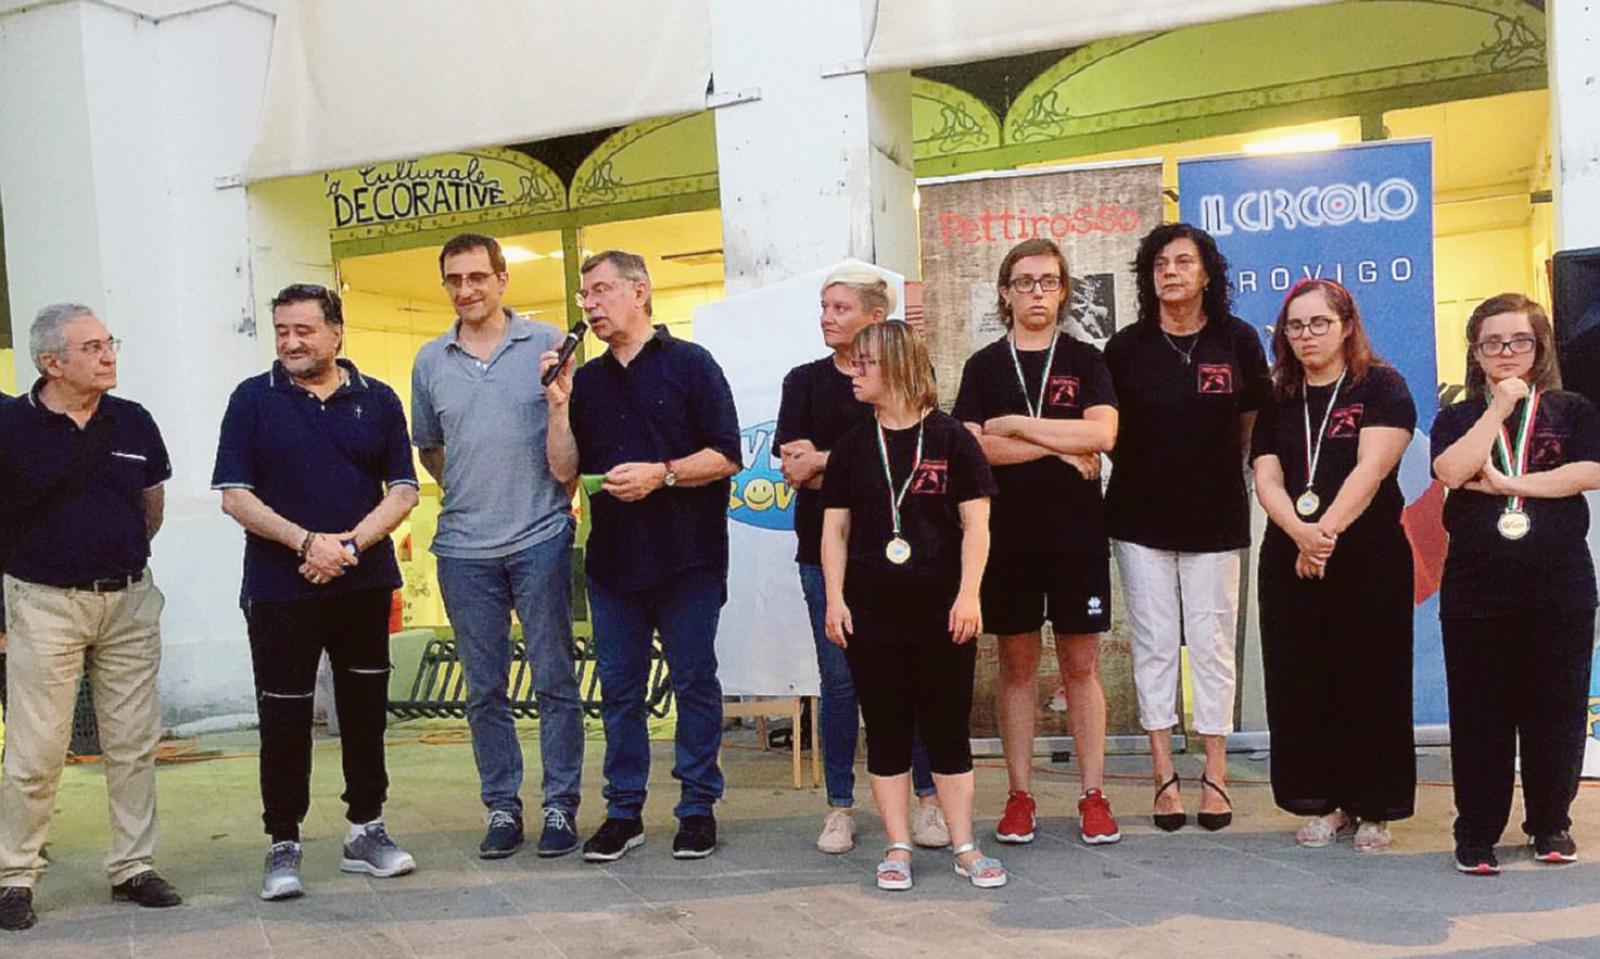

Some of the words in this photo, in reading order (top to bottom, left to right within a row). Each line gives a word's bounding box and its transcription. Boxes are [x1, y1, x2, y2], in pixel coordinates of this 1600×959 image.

[357, 156, 500, 187] Culturale
[334, 181, 506, 227] DECORATIVE
[938, 203, 1140, 247] Pettirosso
[1201, 194, 1233, 235] IL
[1233, 178, 1418, 232] CIRCOLO
[1239, 257, 1412, 293] ROVIGO
